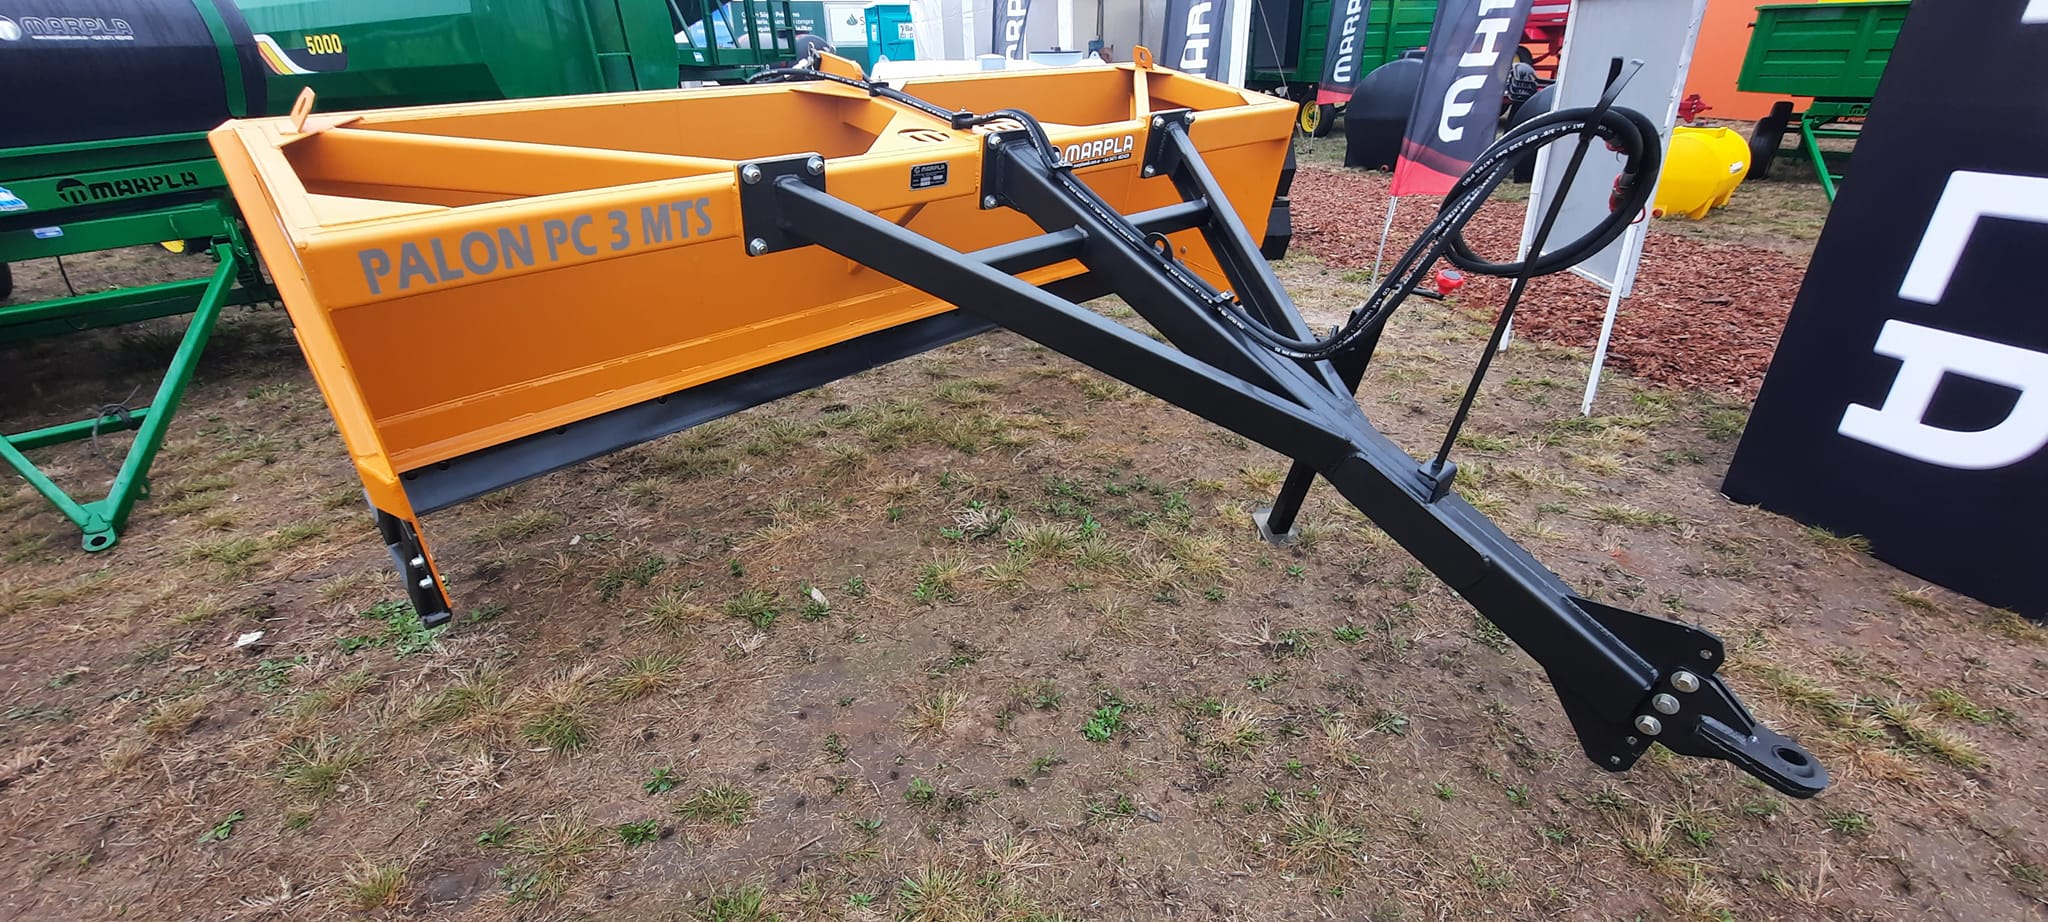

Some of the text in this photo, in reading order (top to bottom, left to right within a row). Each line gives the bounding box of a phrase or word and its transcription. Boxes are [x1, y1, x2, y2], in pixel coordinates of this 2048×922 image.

[20, 16, 134, 35] MARPLA
[304, 33, 343, 55] 5000
[1064, 135, 1134, 162] MARPLA
[87, 171, 199, 200] MARPLA
[358, 197, 713, 295] PALON PC 3 MTS
